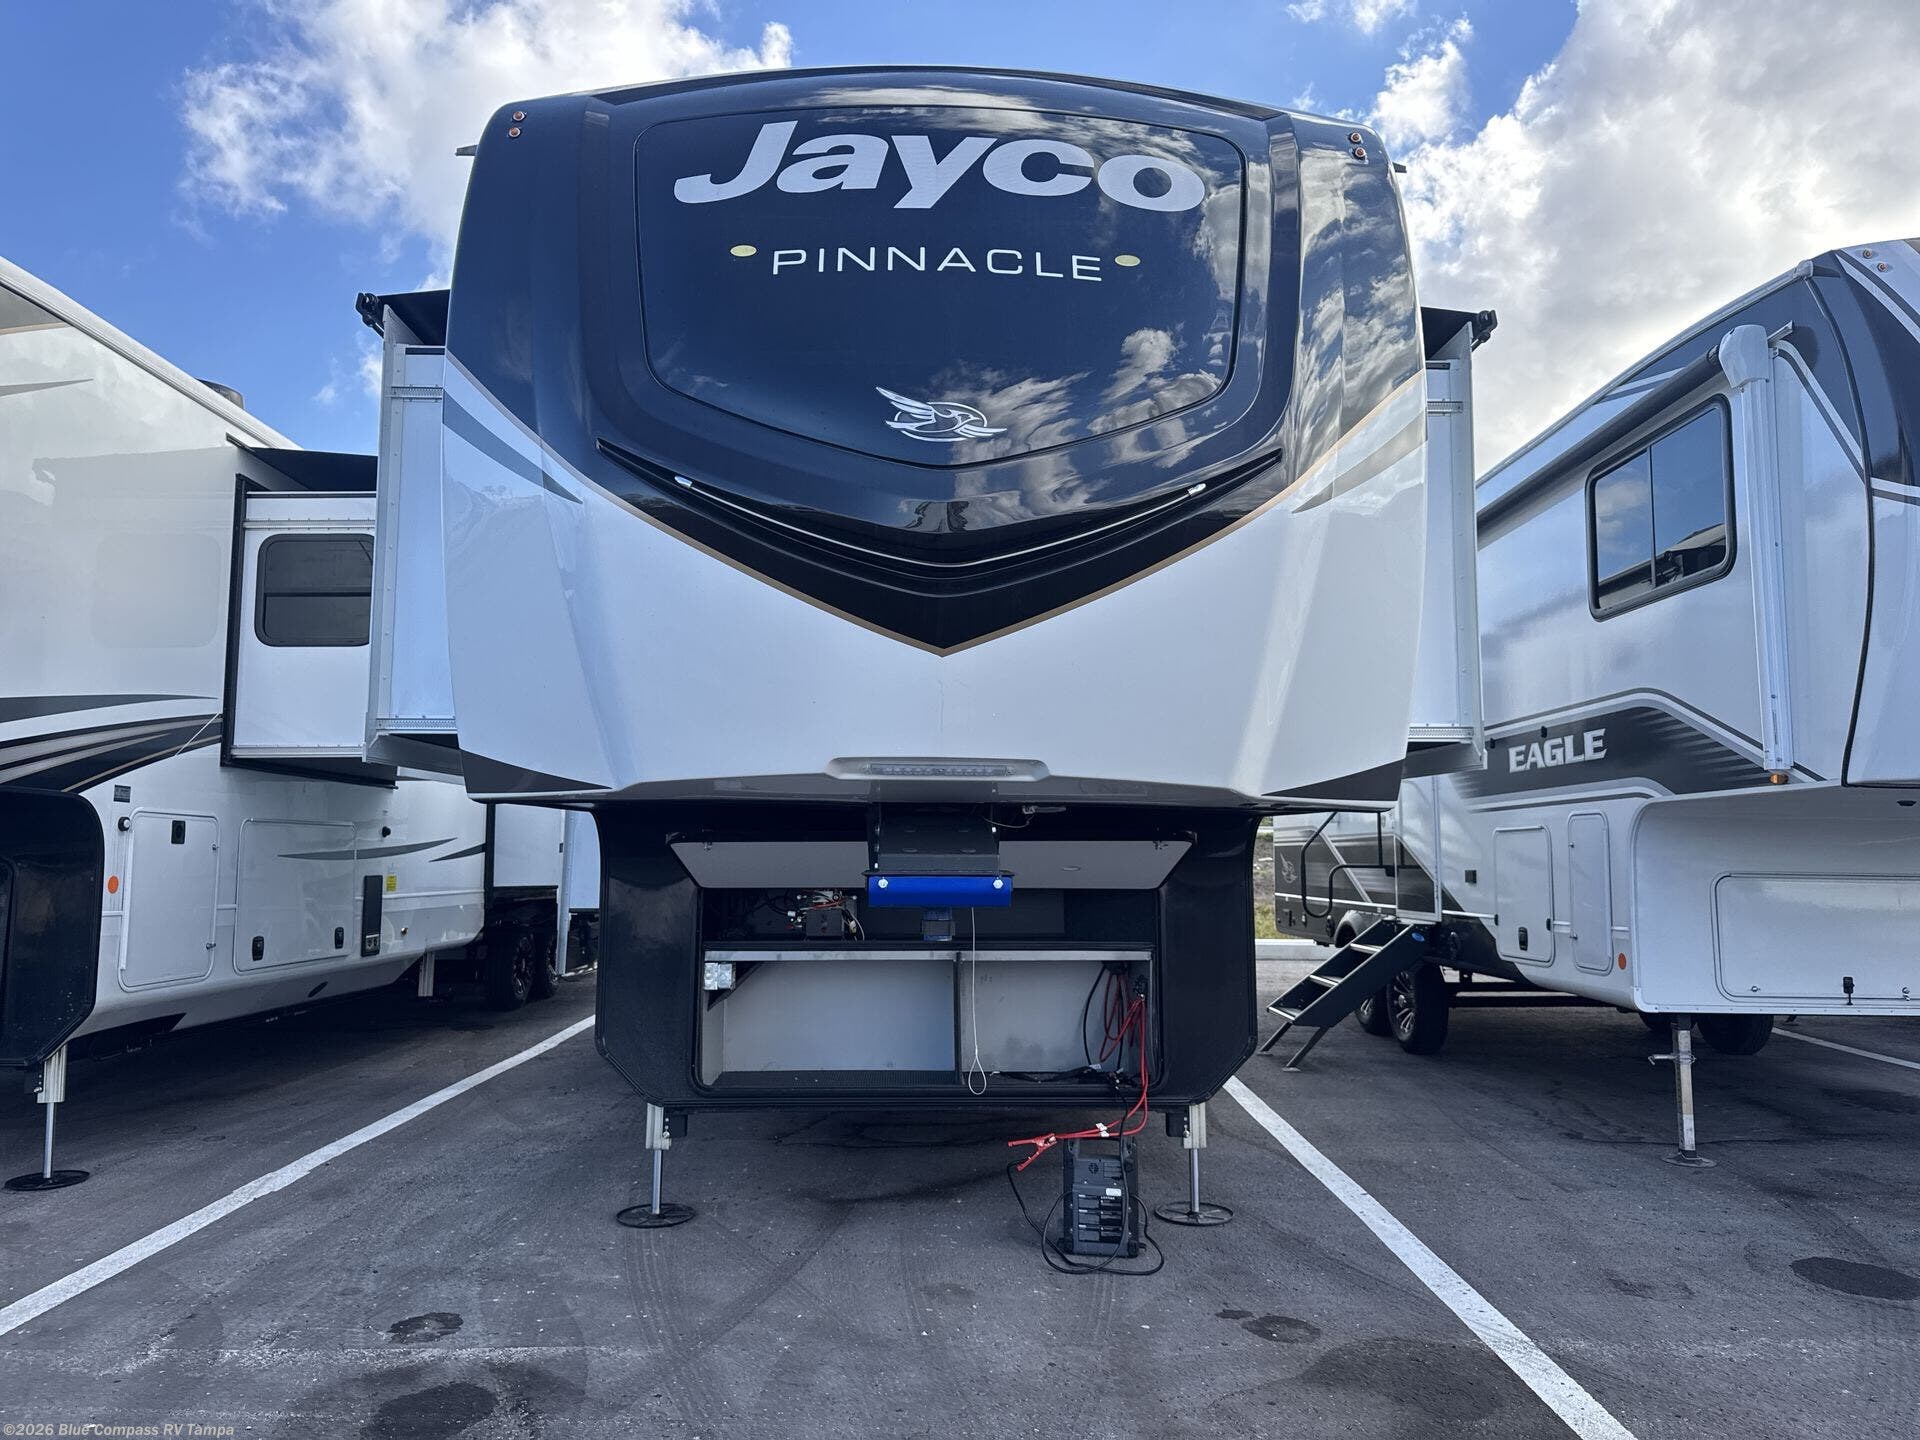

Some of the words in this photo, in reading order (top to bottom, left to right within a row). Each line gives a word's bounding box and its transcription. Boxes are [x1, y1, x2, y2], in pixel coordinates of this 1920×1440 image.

[673, 120, 1206, 212] Jayco
[772, 246, 1103, 282] PINNACLE
[1508, 728, 1607, 773] EAGLE
